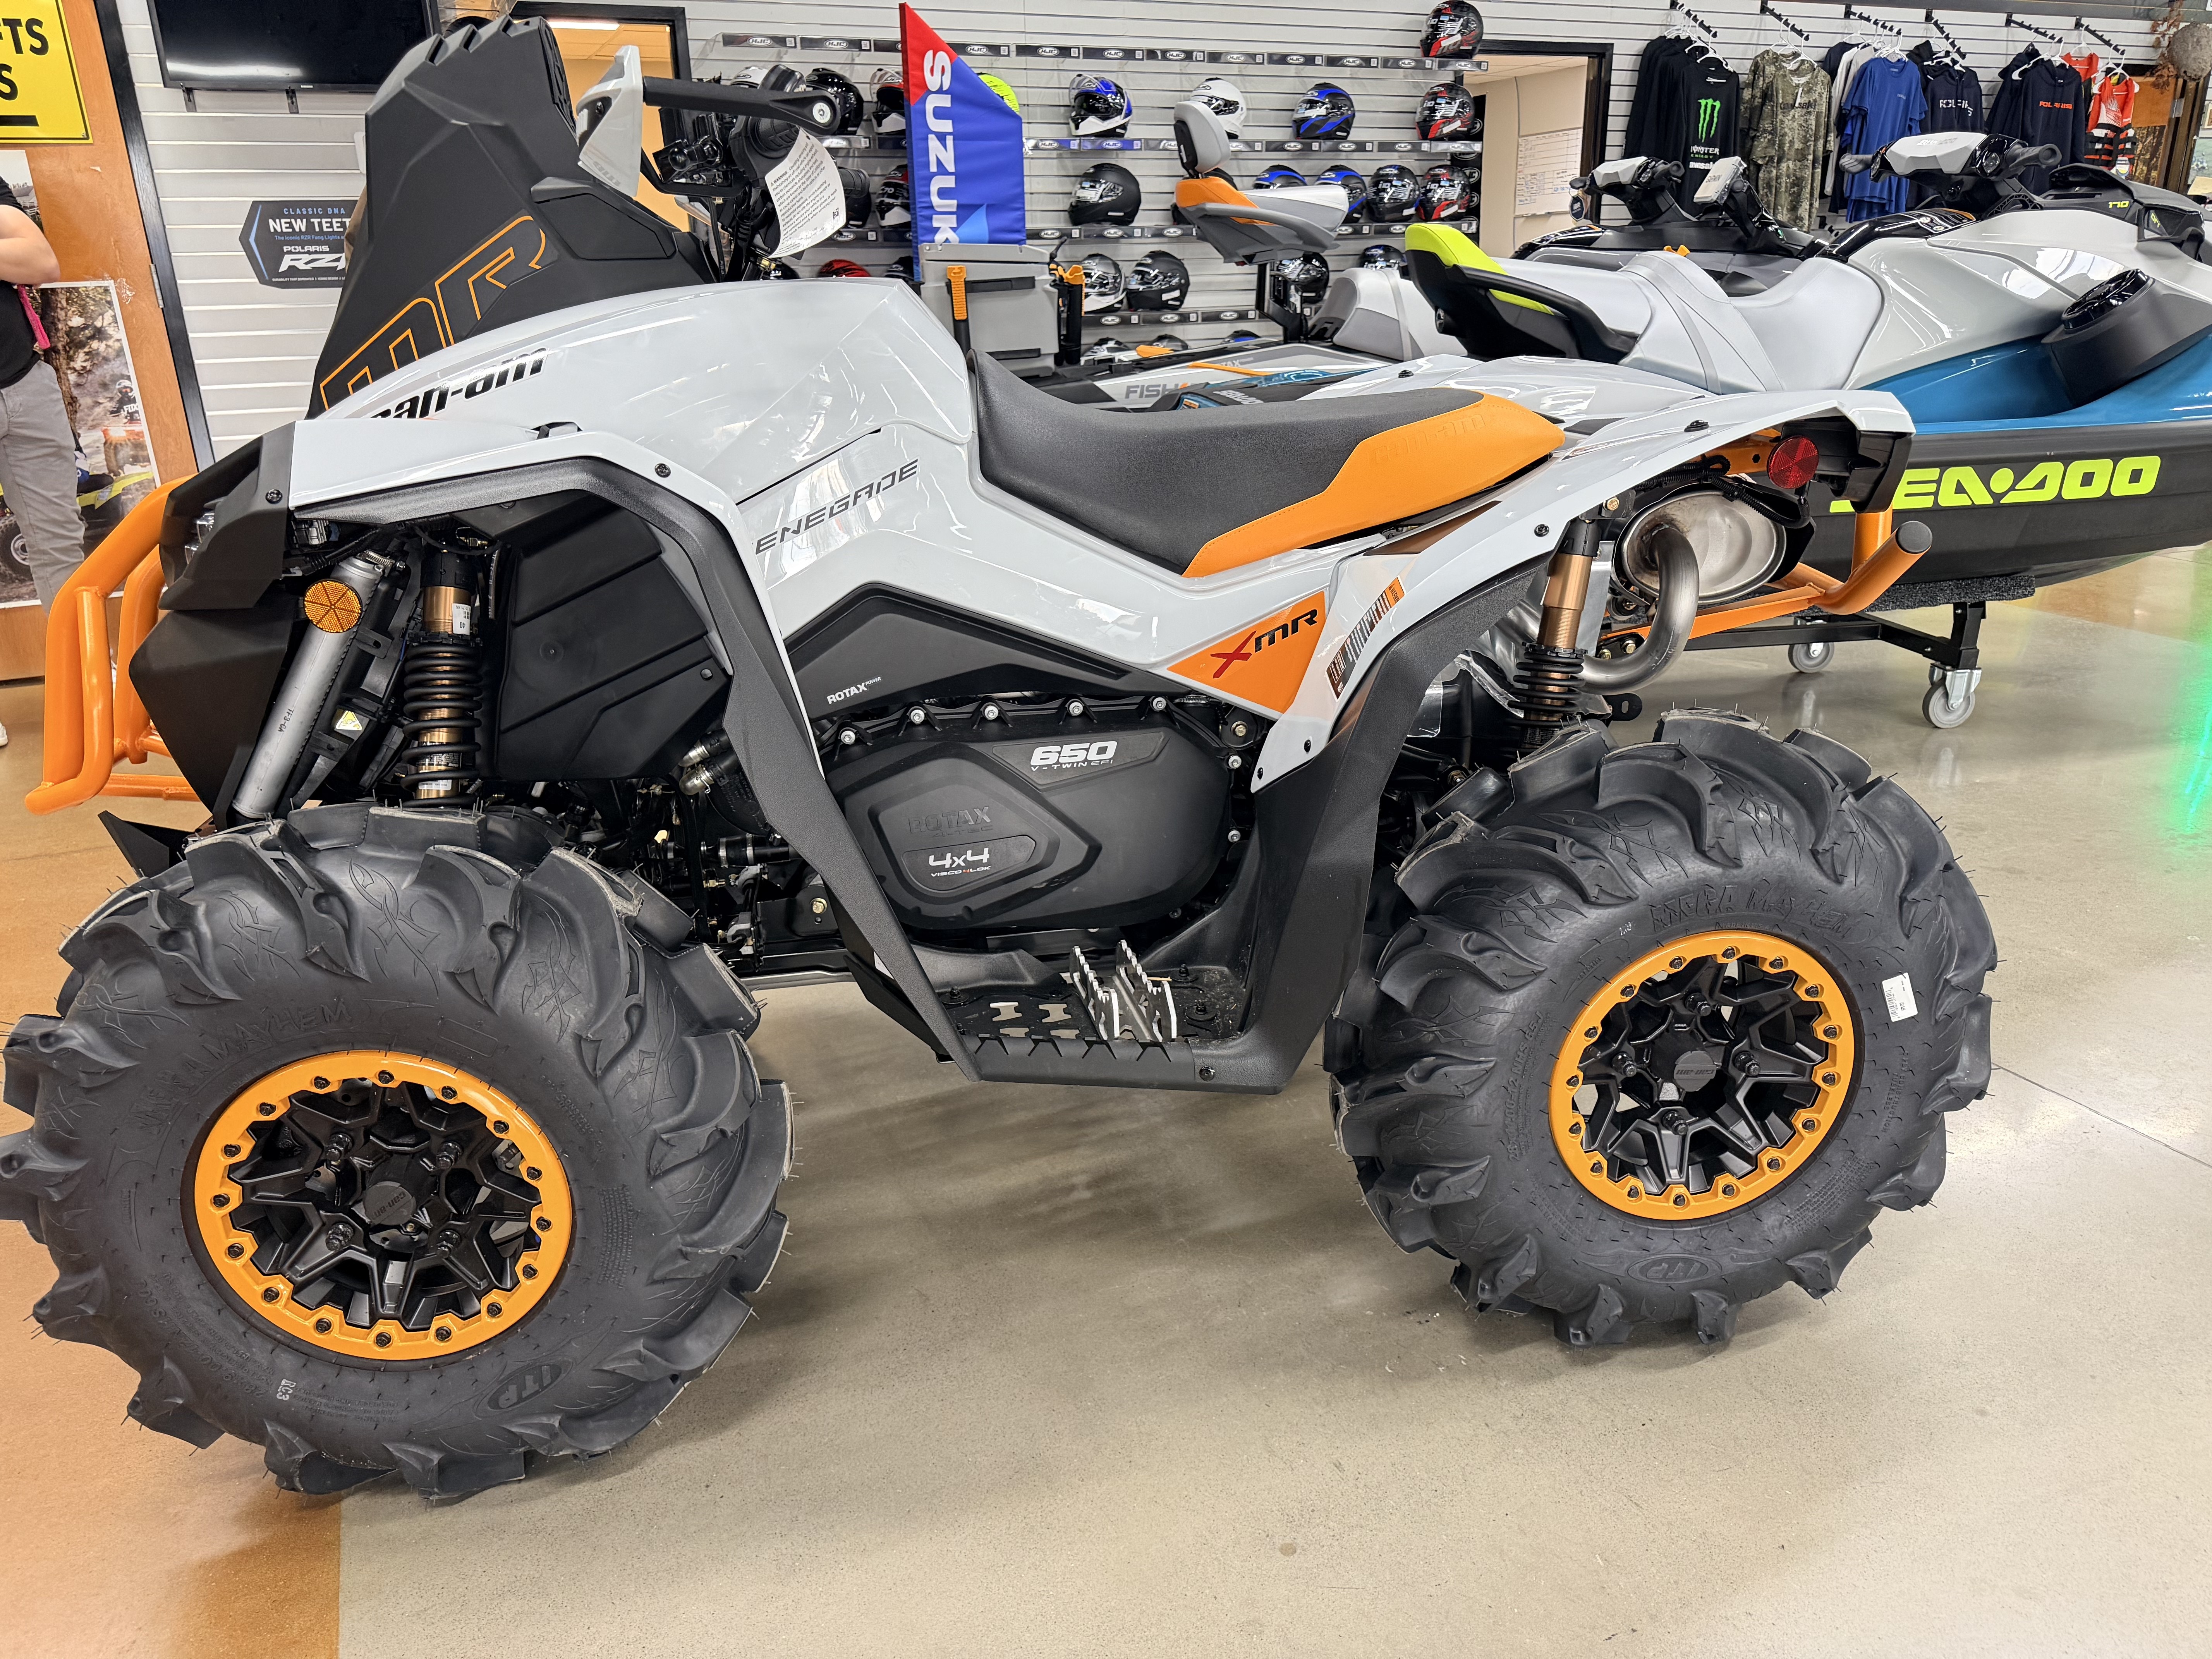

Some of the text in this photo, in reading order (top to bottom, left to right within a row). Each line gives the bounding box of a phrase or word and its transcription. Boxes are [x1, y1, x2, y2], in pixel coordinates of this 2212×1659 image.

[0, 18, 49, 56] TS
[923, 50, 960, 244] SUZUK
[269, 218, 351, 232] NEW TEET
[751, 459, 919, 555] ENEGADE
[826, 676, 881, 704] ROTAX POWER
[1030, 740, 1118, 766] 650
[908, 806, 992, 834] ROTAX
[929, 847, 989, 869] 4x4
